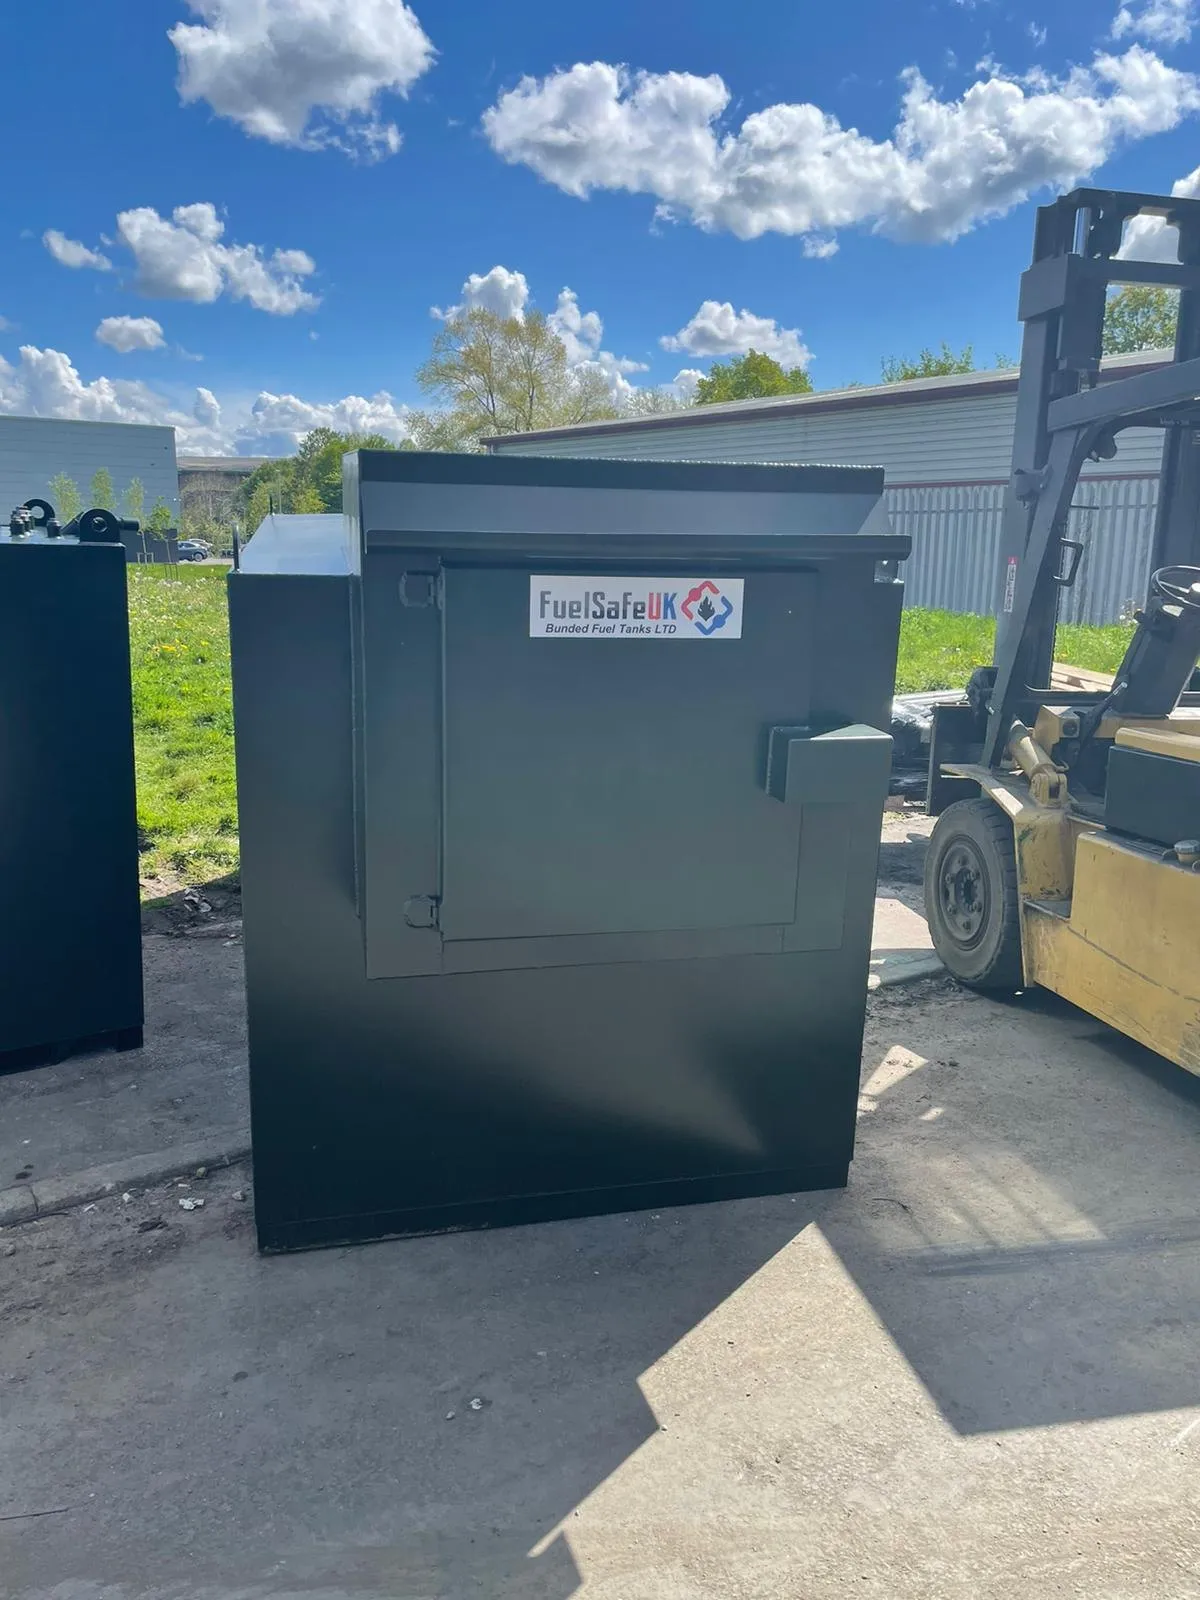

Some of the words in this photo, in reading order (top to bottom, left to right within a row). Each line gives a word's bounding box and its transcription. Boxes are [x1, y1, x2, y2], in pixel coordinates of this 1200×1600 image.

[539, 590, 678, 620] FuelSafeUK
[545, 623, 588, 633] Bunded
[591, 623, 616, 633] Fuel
[619, 624, 651, 634] Tanks
[655, 624, 677, 634] LTD
